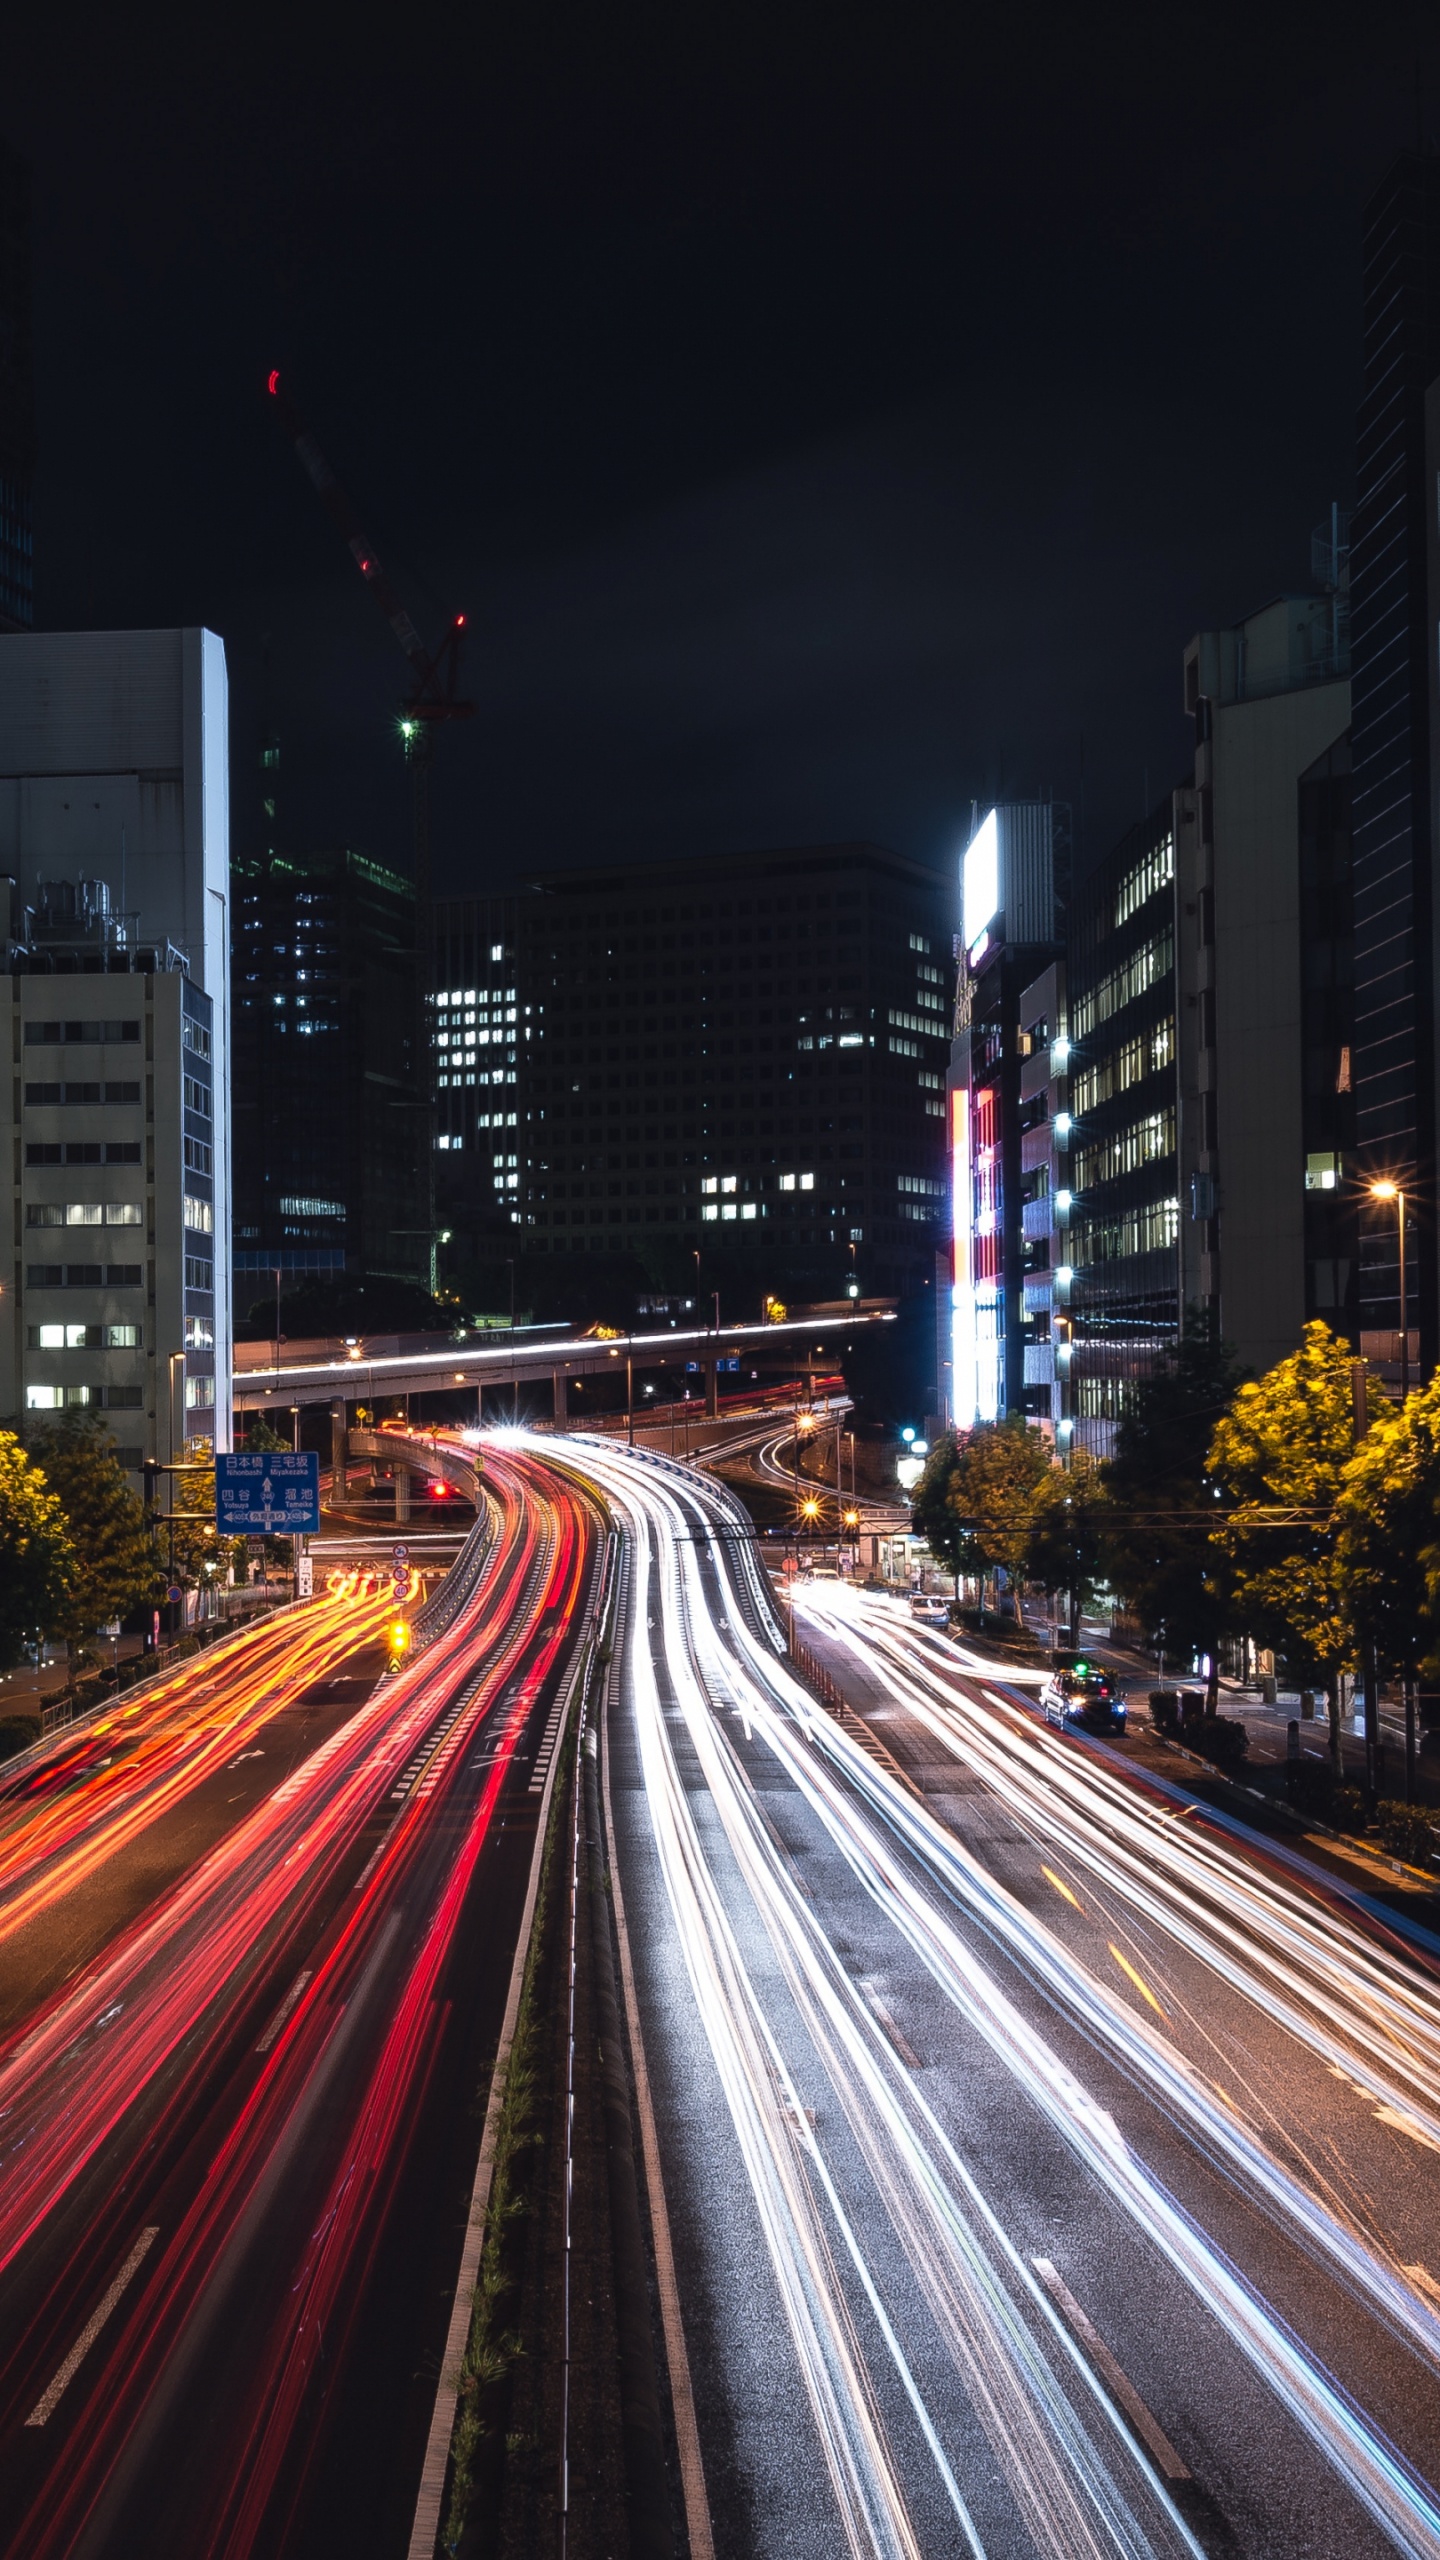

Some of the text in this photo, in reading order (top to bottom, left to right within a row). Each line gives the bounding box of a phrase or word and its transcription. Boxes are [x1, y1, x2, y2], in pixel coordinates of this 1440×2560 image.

[226, 1456, 308, 1468] 日本橋 三宅坂
[270, 1469, 309, 1477] Miyakezaka
[222, 1490, 250, 1501] 四谷
[285, 1489, 314, 1500] 溜池
[396, 1587, 405, 1595] 40
